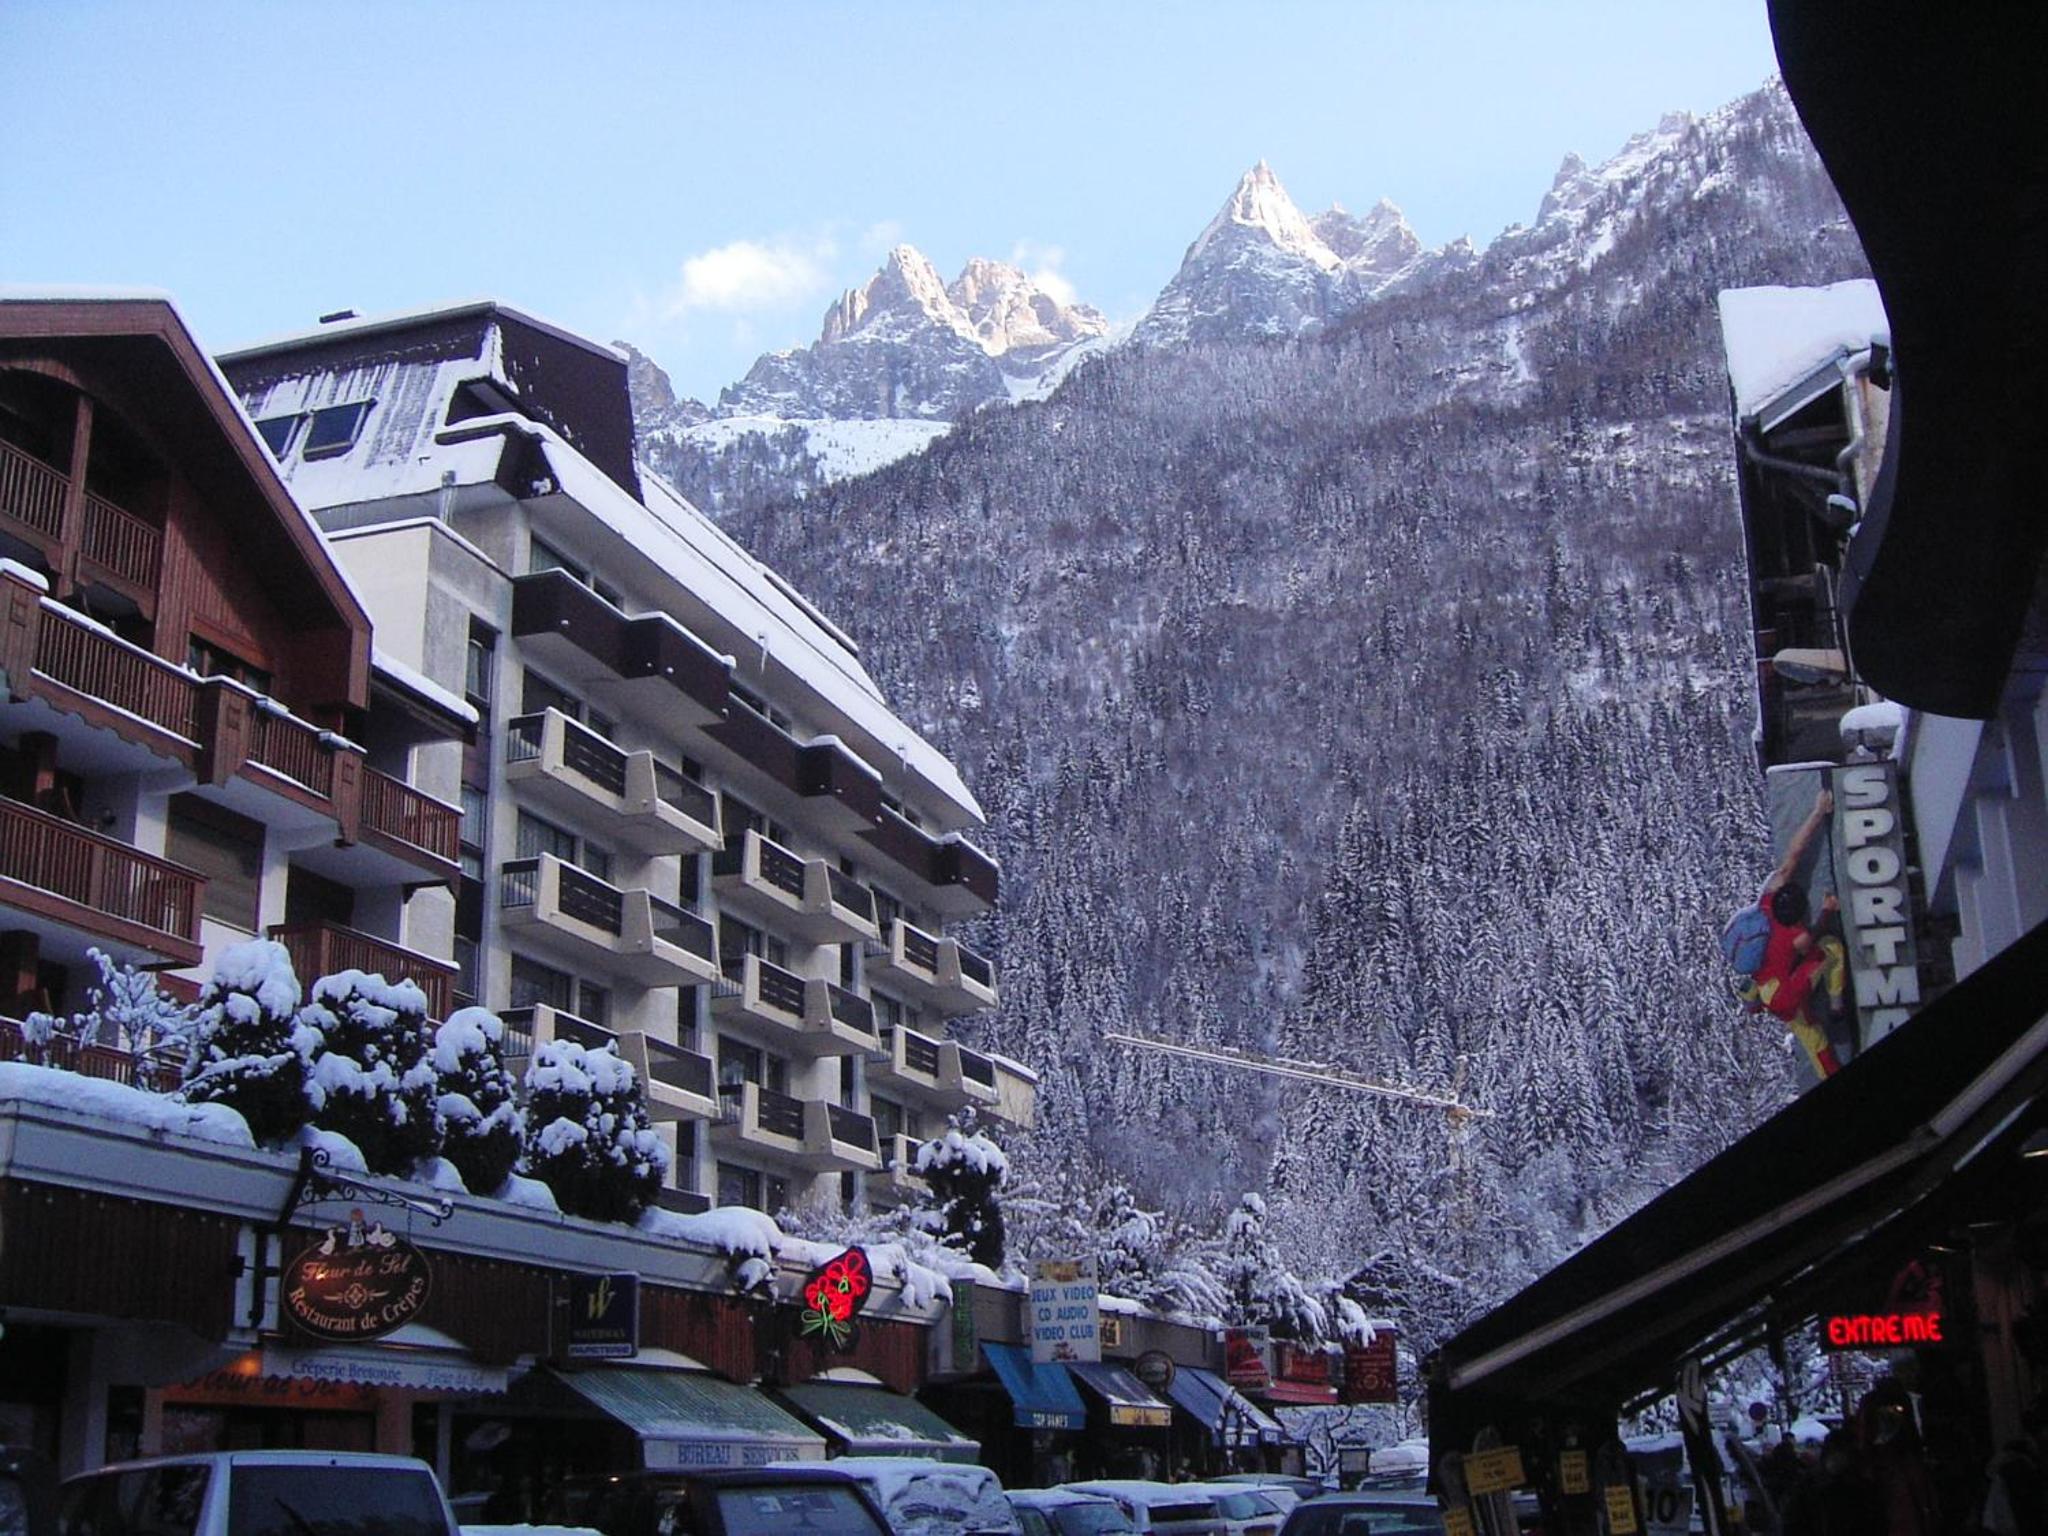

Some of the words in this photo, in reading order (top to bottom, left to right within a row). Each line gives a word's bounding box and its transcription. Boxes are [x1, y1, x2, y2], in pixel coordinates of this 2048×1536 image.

[302, 1261, 351, 1283] Fleur
[353, 1258, 375, 1277] de
[378, 1252, 413, 1275] Sel
[1032, 1287, 1057, 1303] JEUX
[1062, 1285, 1095, 1301] VIDEO
[288, 1285, 357, 1331] Restaurant
[360, 1311, 379, 1331] de
[1038, 1307, 1052, 1322] CD
[1056, 1305, 1089, 1320] AUDIO
[1033, 1325, 1065, 1341] VIDEO
[1069, 1323, 1095, 1340] CLUB
[1827, 1311, 1945, 1346] EXTREME
[348, 1361, 402, 1381] Bretonne
[678, 1444, 731, 1465] BUREAU
